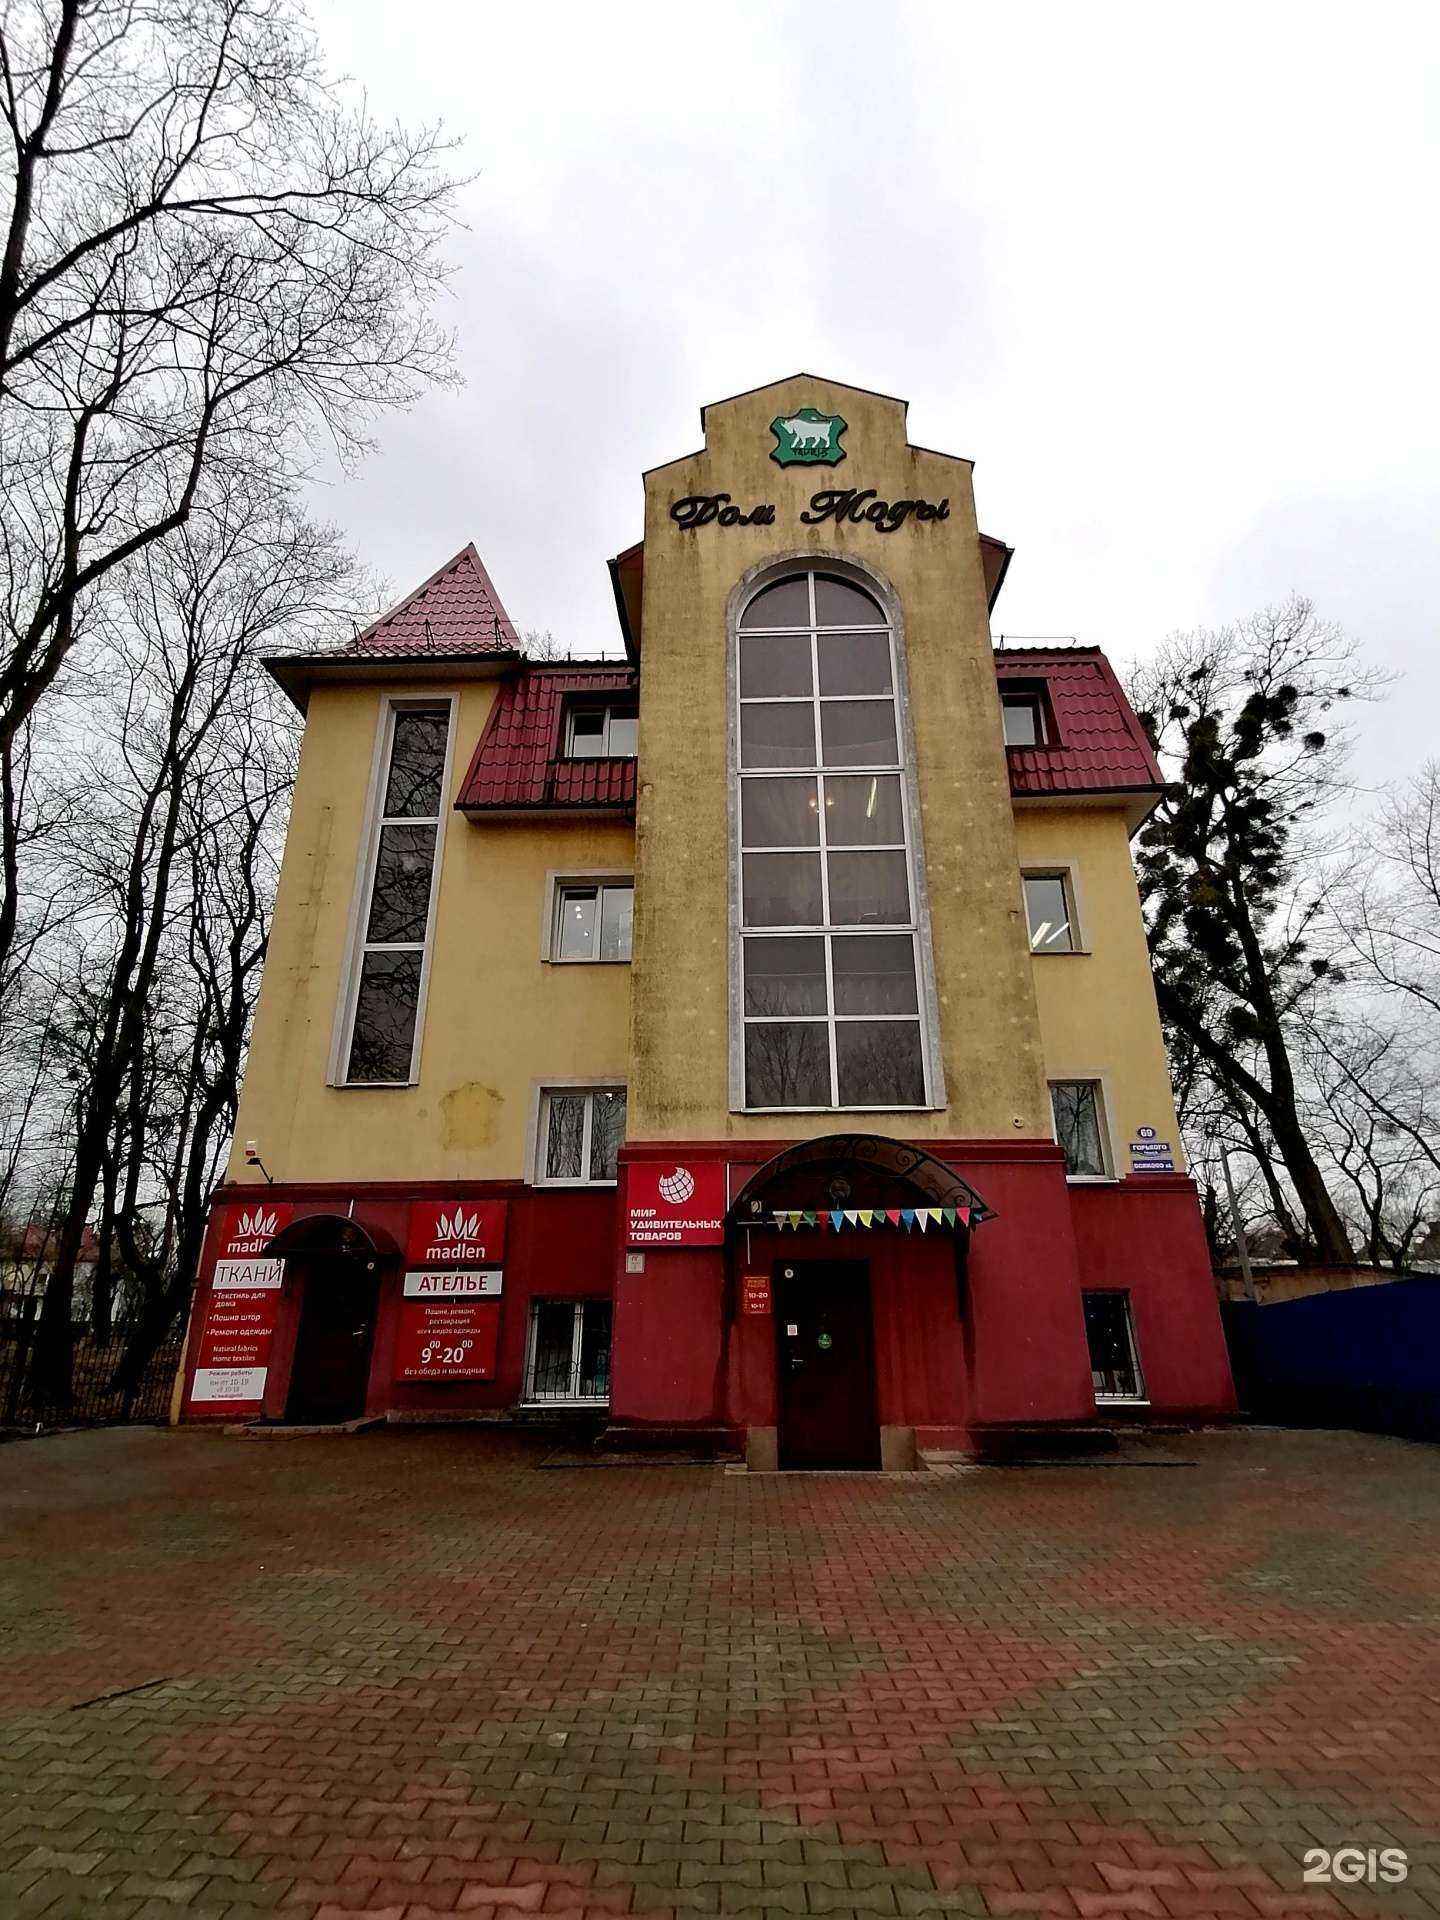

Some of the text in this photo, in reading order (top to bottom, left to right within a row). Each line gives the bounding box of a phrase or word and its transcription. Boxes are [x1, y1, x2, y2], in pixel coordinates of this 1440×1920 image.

[670, 489, 949, 532] Дом Моды
[1140, 1129, 1152, 1137] 69
[630, 1209, 656, 1217] МИР
[630, 1221, 720, 1229] УДИВИТЕЛЬНЫХ
[630, 1232, 682, 1240] ТОВАРОВ
[426, 1243, 485, 1259] madlen
[418, 1275, 488, 1291] АТЕЛЬЕ
